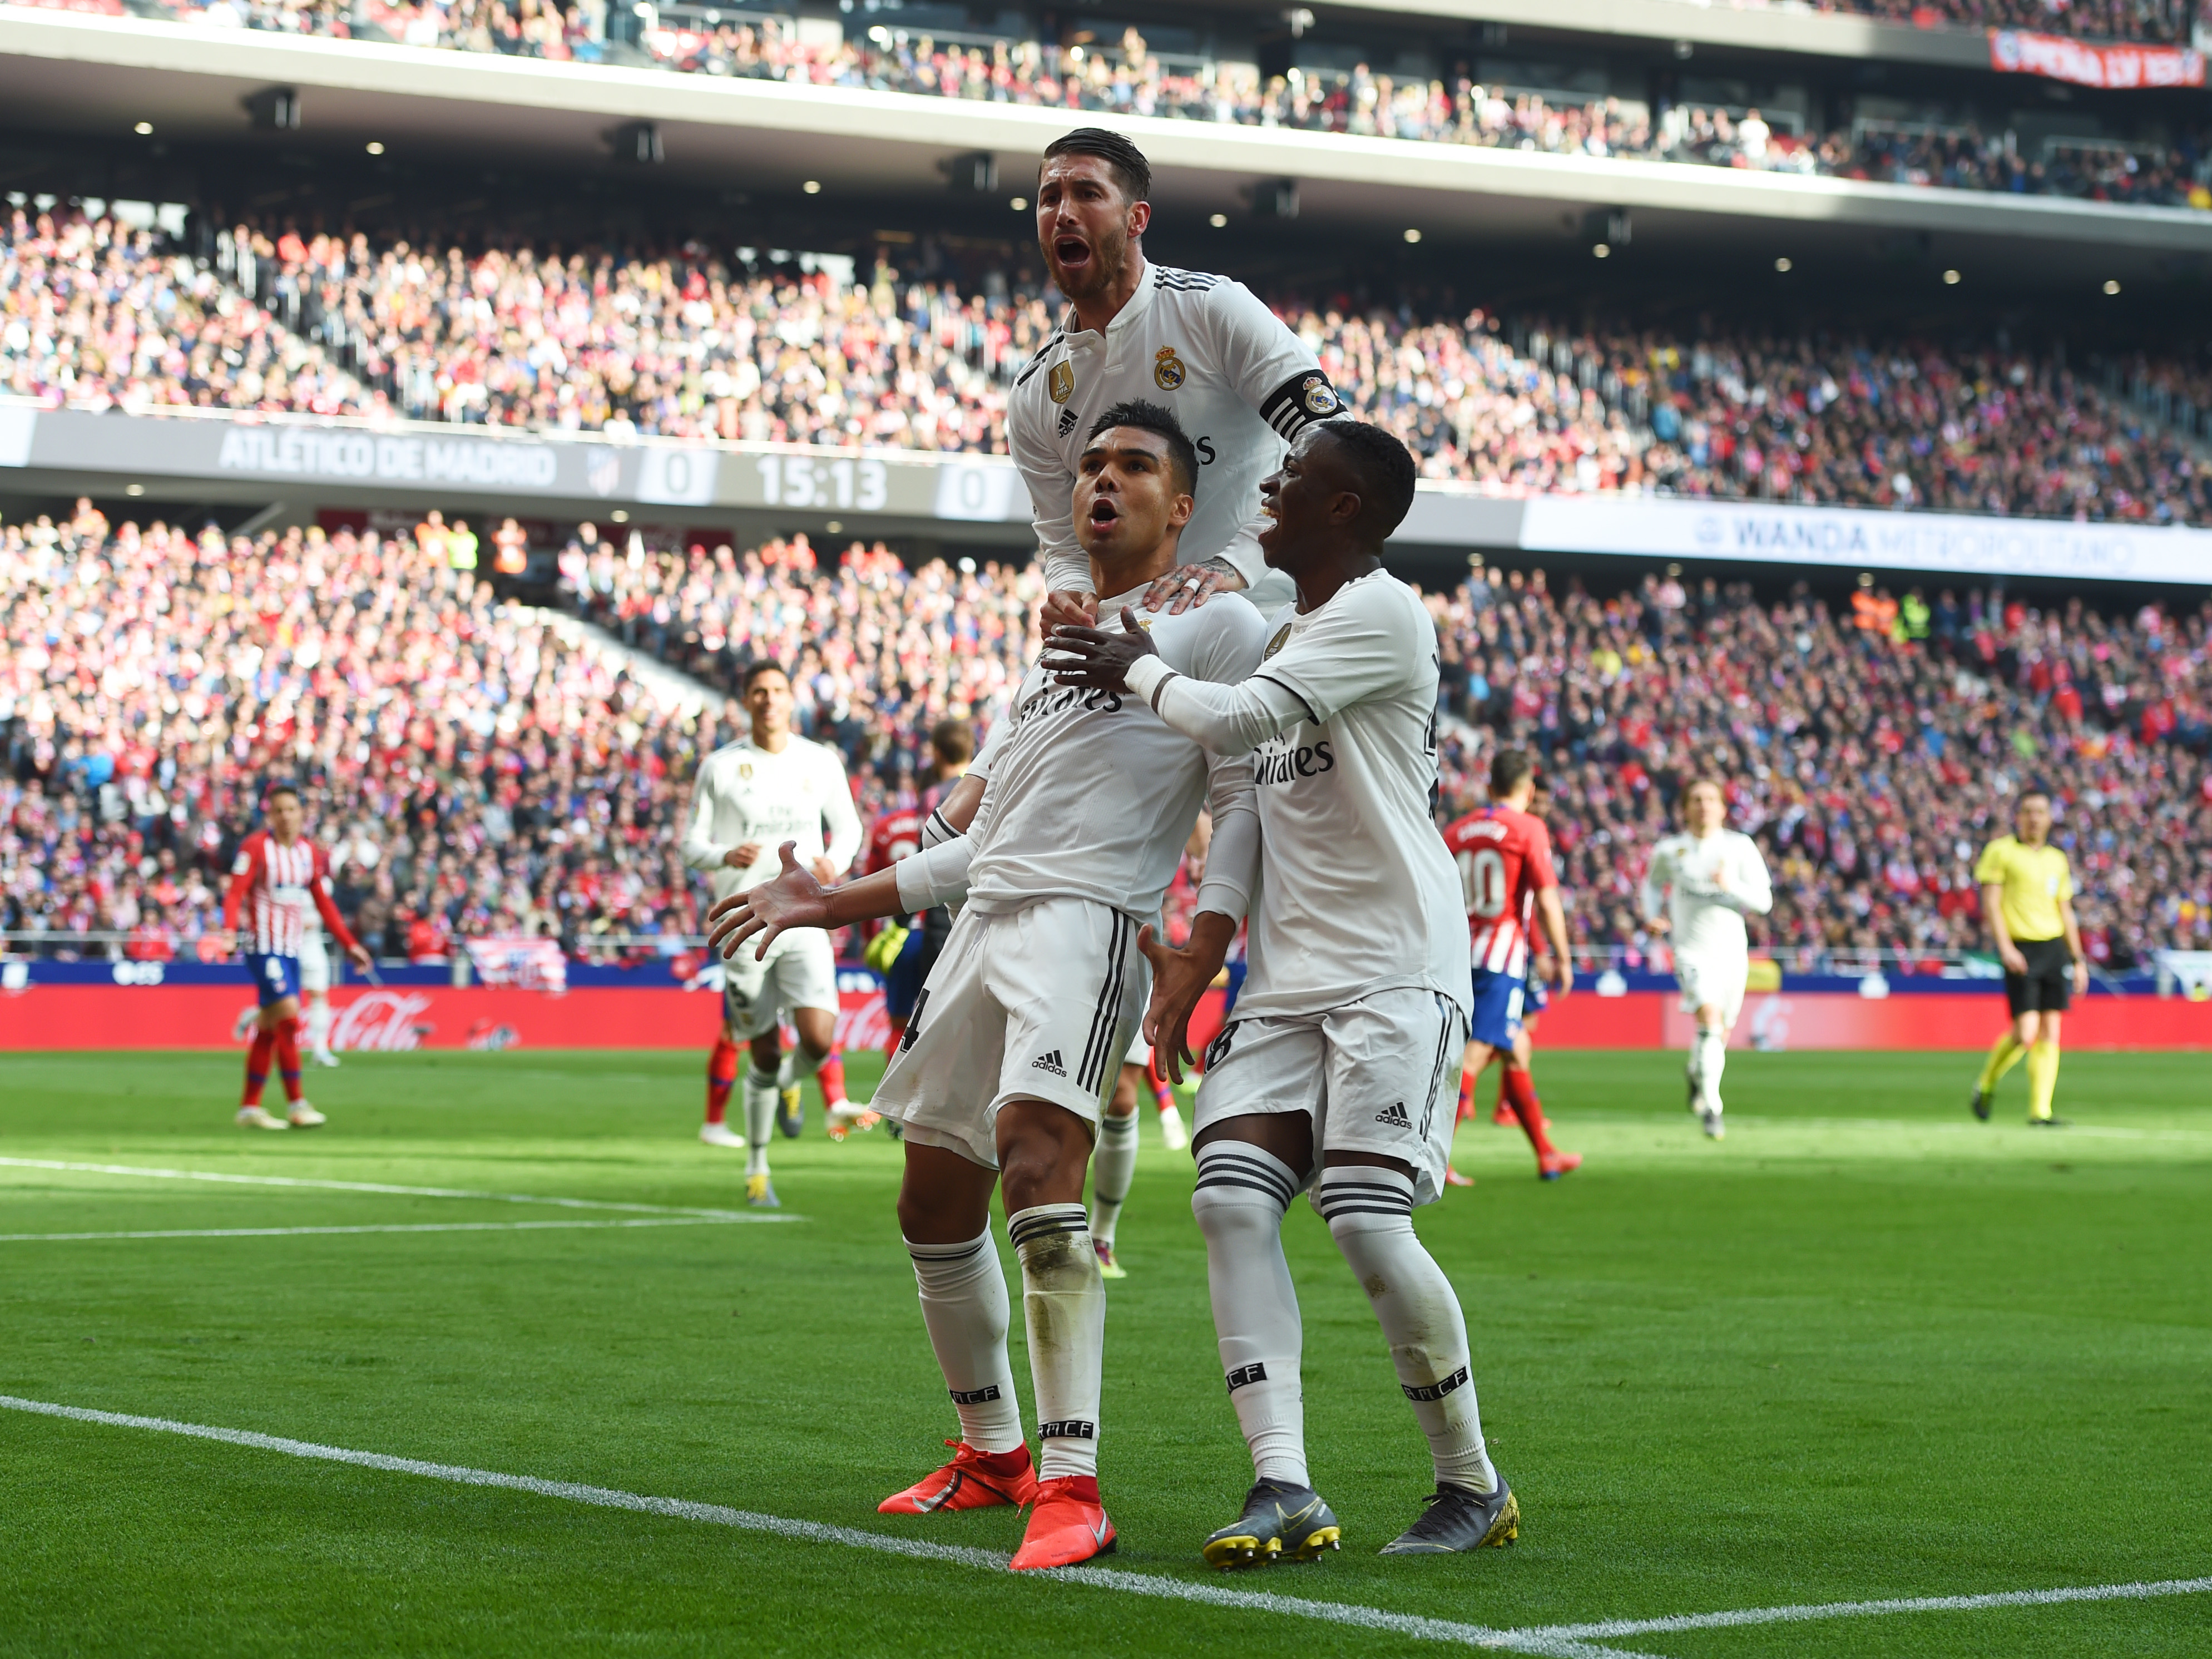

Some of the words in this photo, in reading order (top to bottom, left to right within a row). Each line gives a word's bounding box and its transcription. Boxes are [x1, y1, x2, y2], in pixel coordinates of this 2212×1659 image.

[219, 427, 375, 476] ATLÉTICO
[376, 436, 423, 479] DE
[424, 443, 556, 487] MADRID
[668, 453, 691, 494] 0
[756, 456, 887, 511] 15:13
[959, 468, 984, 511] 0
[1734, 517, 1871, 553] WANDA
[1254, 741, 1334, 785] irates
[1456, 848, 1507, 919] 10
[1032, 1061, 1067, 1078] adidas
[1375, 1115, 1412, 1130] adidas
[952, 1388, 994, 1404] MCF
[1227, 1365, 1258, 1391] CF
[1403, 1370, 1464, 1400] RMCF
[1037, 1422, 1092, 1439] RMCF
